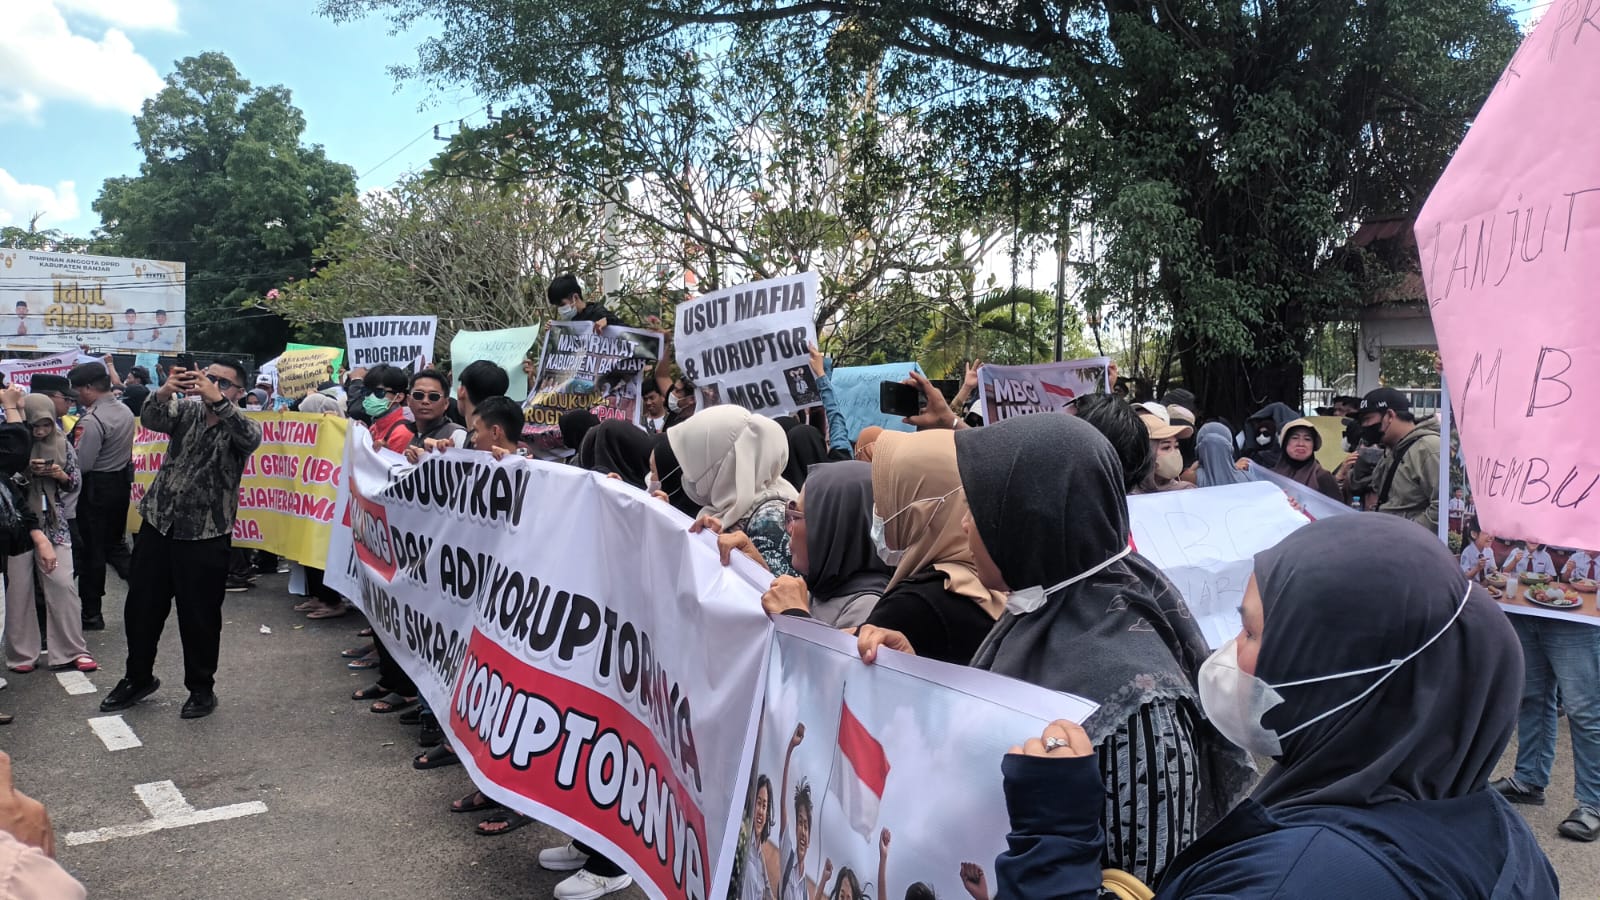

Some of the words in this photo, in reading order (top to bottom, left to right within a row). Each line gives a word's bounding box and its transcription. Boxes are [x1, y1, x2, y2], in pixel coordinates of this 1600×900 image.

[29, 255, 65, 263] PIMPINAN
[39, 262, 82, 270] KABUPATEN
[53, 281, 106, 305] Idul
[44, 303, 114, 330] Adha
[683, 296, 730, 336] USUT
[735, 281, 806, 322] MAFIA
[348, 320, 431, 339] LANJUTKAN
[355, 344, 422, 365] PROGRAM
[684, 357, 699, 381] &
[701, 326, 810, 378] KORUPTOR
[728, 378, 781, 411] MBG
[993, 378, 1041, 405] MBG
[260, 454, 299, 478] GRATIS
[391, 525, 433, 585] DAN
[372, 584, 401, 642] MBG
[456, 650, 707, 900] KORUPTORNYA
